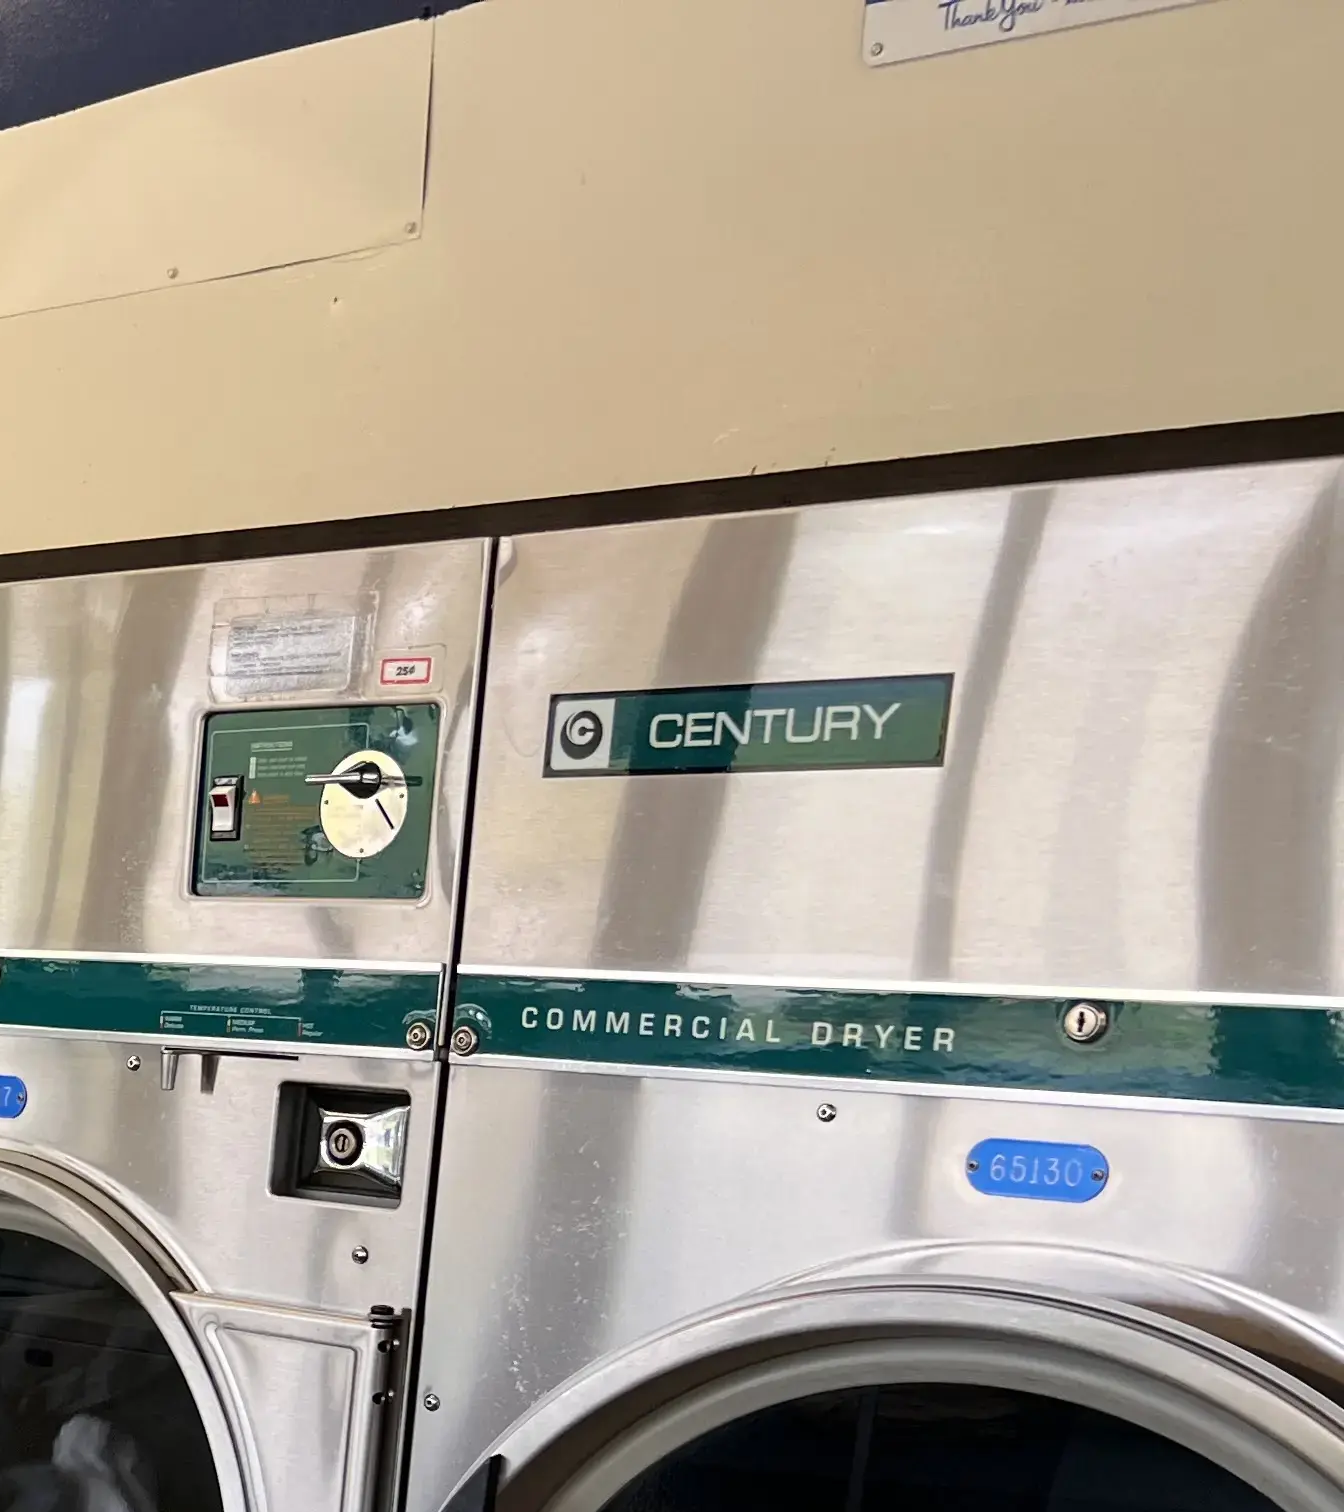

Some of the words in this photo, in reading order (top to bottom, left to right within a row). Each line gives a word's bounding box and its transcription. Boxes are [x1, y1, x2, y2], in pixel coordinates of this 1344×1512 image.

[649, 702, 902, 750] CENTURY
[520, 1006, 783, 1044] COMMERCIAL
[810, 1020, 957, 1053] DRYER
[988, 1152, 1084, 1188] 65130
